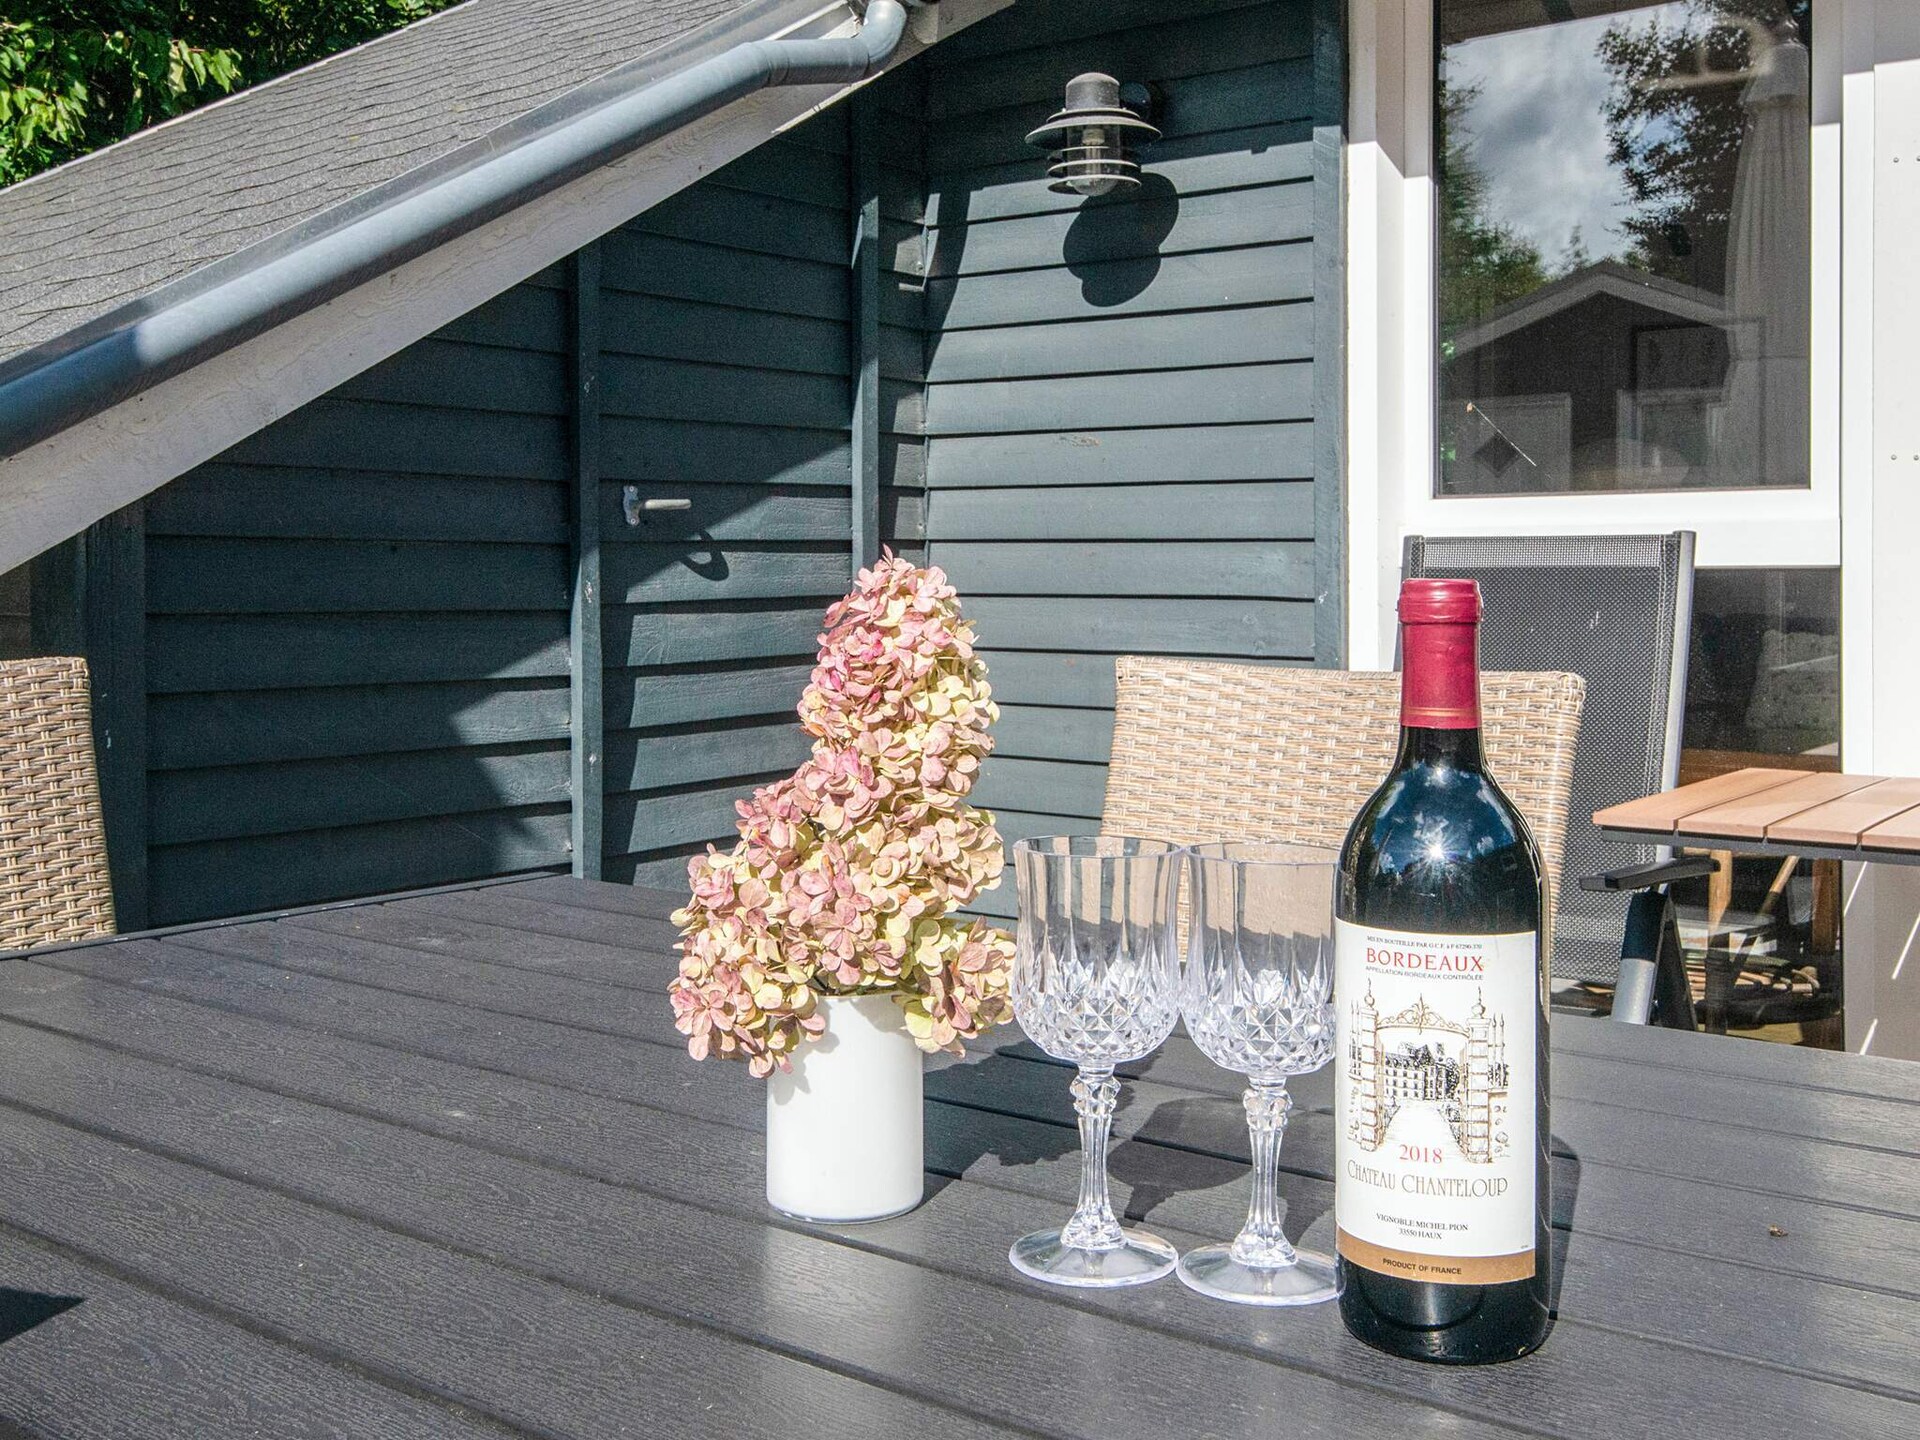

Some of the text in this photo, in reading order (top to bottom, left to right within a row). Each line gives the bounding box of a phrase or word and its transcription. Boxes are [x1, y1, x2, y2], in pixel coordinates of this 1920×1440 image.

[1366, 947, 1484, 972] BORDEAUX
[1365, 965, 1404, 977] APPELLATION
[1404, 970, 1442, 980] BORDEAUX
[1399, 1144, 1443, 1164] 2018
[1347, 1159, 1508, 1198] CHATEAU CHANTELOUP
[1376, 1212, 1469, 1231] VIGNOBLE MICHEL PION
[1418, 1230, 1442, 1240] HAUX
[1382, 1258, 1462, 1275] PRODUCT OF FRANCE
